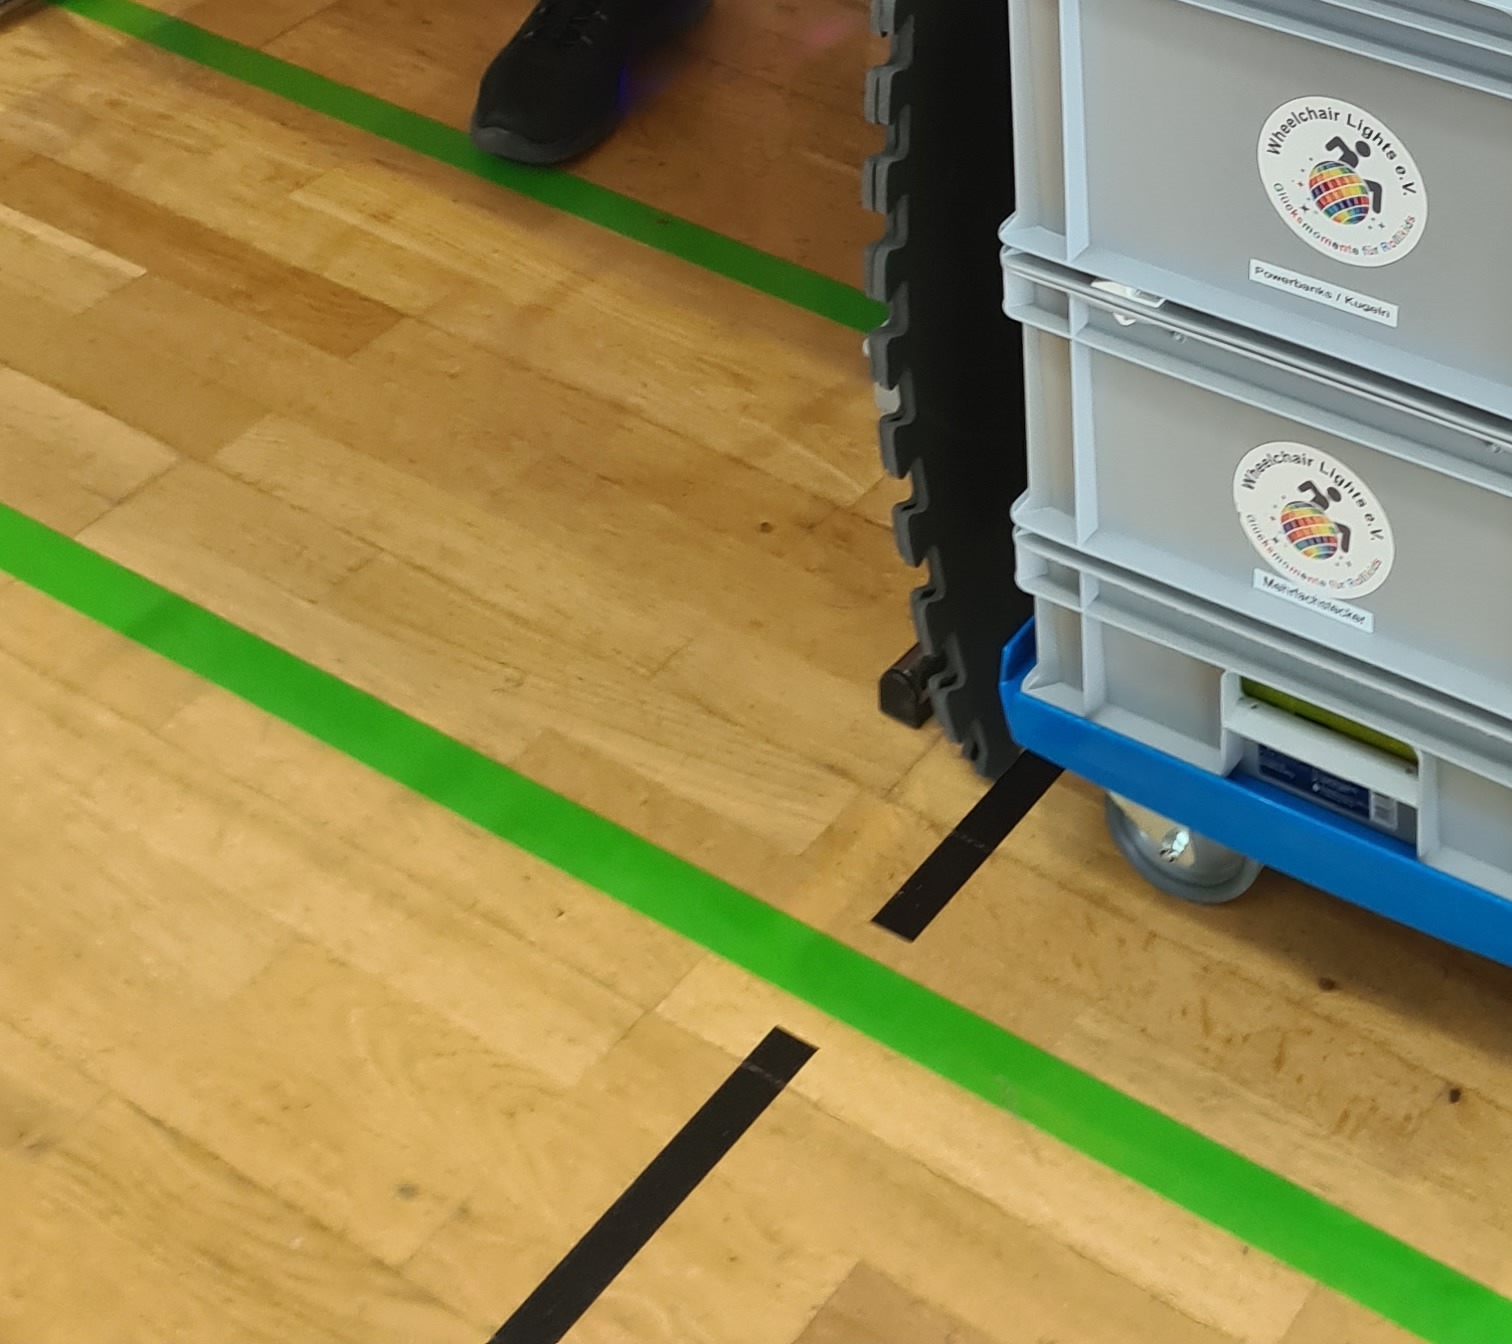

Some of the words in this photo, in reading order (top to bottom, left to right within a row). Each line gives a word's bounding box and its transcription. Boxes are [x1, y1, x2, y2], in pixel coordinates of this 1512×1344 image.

[1267, 107, 1341, 156] Wheelchair
[1347, 113, 1397, 161] Lights
[1255, 266, 1333, 300] Powerbanks
[1242, 451, 1315, 491] Wheelchair
